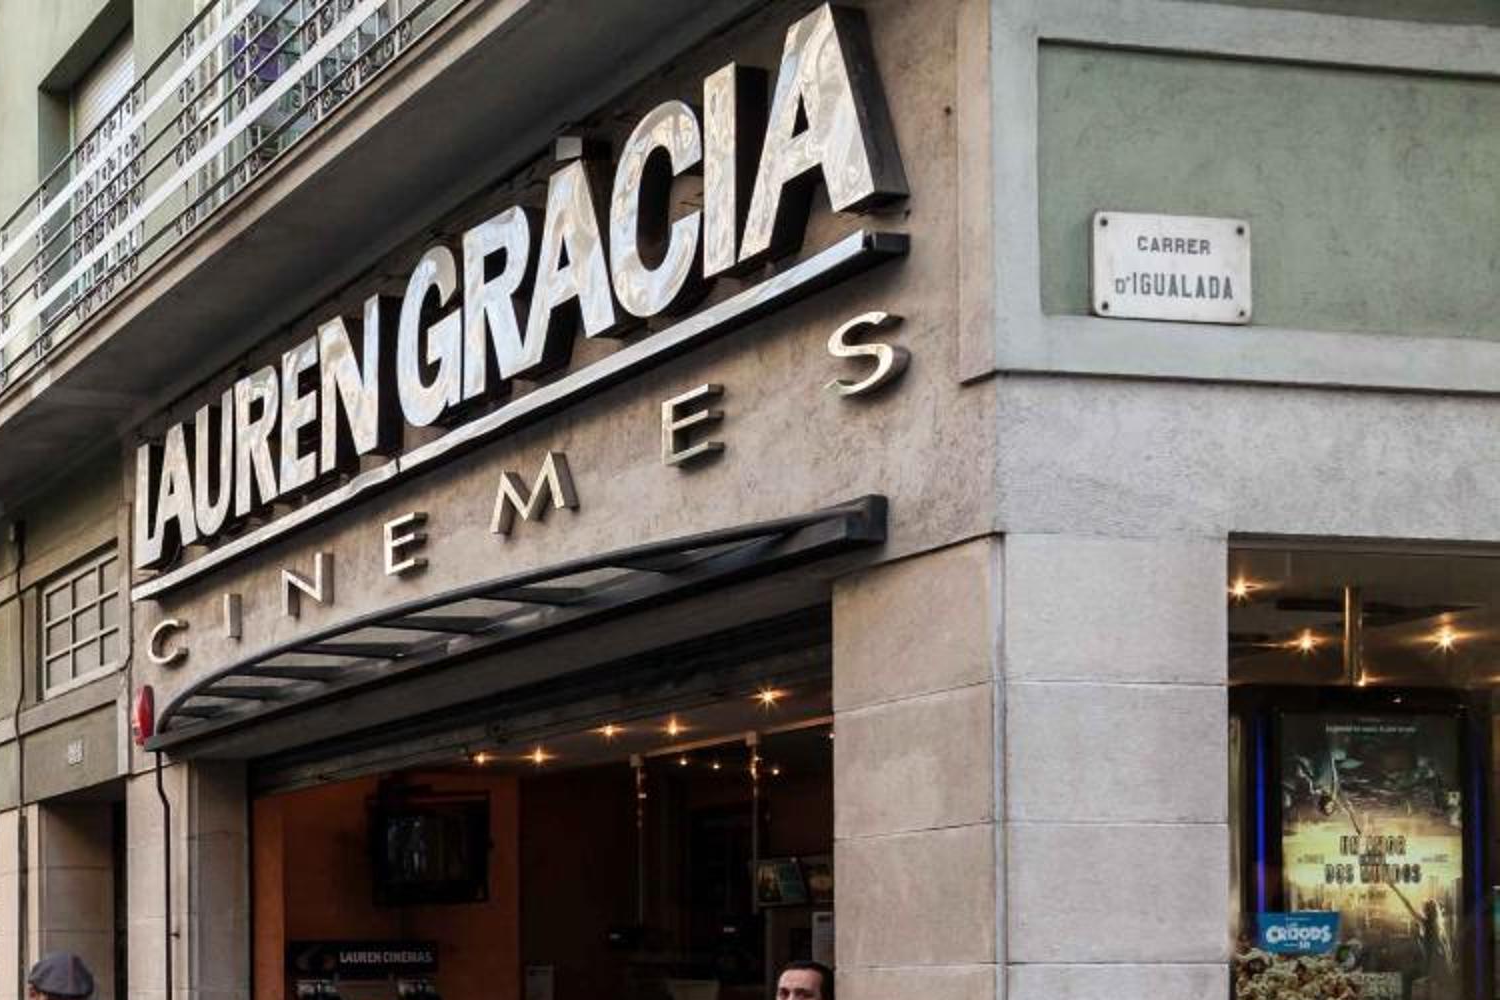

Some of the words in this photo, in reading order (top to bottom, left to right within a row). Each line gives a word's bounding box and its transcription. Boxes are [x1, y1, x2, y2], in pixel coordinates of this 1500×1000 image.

[1137, 236, 1211, 255] CARRER
[136, 296, 382, 570] LAUREN
[148, 312, 905, 666] CINEMES
